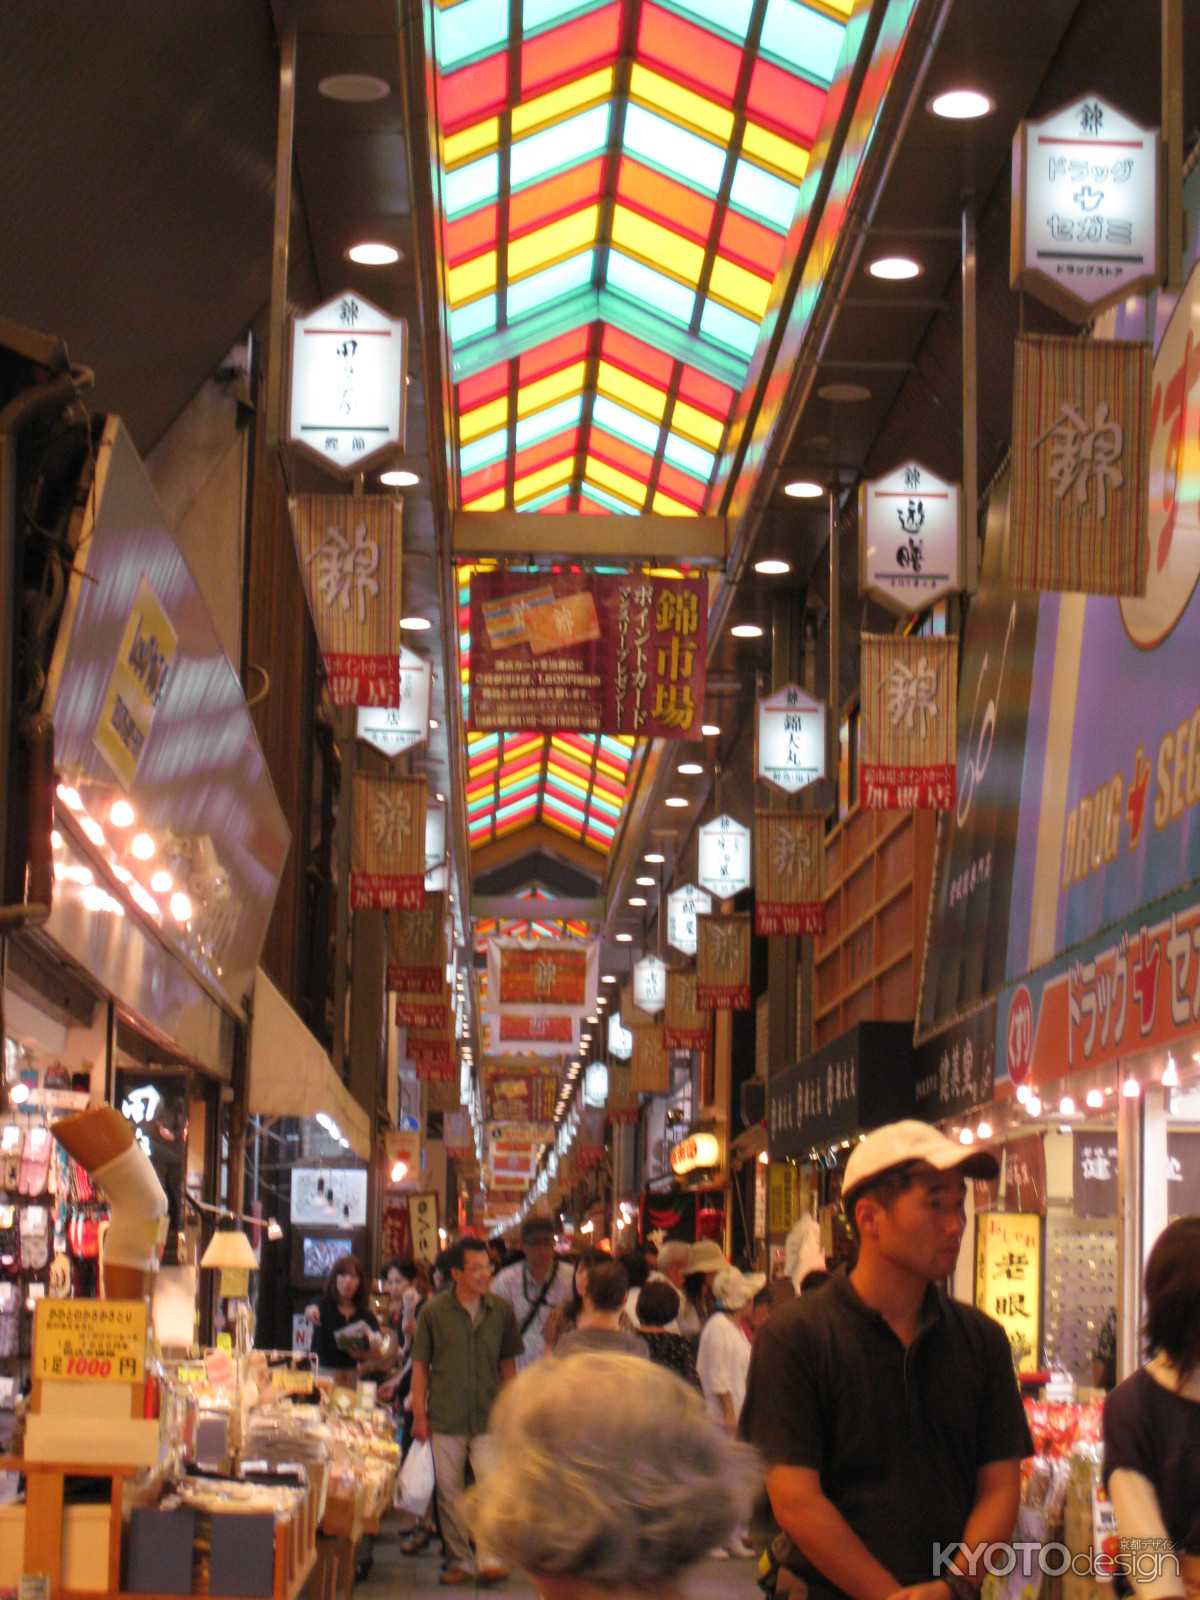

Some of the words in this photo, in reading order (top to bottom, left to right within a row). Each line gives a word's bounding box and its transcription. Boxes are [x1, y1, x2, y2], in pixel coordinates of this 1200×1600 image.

[1048, 155, 1135, 183] ドラッグ
[1047, 214, 1133, 244] セガミ
[1056, 264, 1123, 277] ドラッグストア
[1032, 402, 1125, 519] 錦
[304, 518, 379, 626] 錦
[632, 584, 654, 730] ポイントカード
[653, 588, 698, 730] 錦市場
[878, 661, 939, 743] 錦
[866, 784, 951, 808] 加盟店
[1067, 930, 1130, 1065] ドラッグ
[65, 1357, 112, 1376] 1000
[119, 1358, 137, 1376] 円
